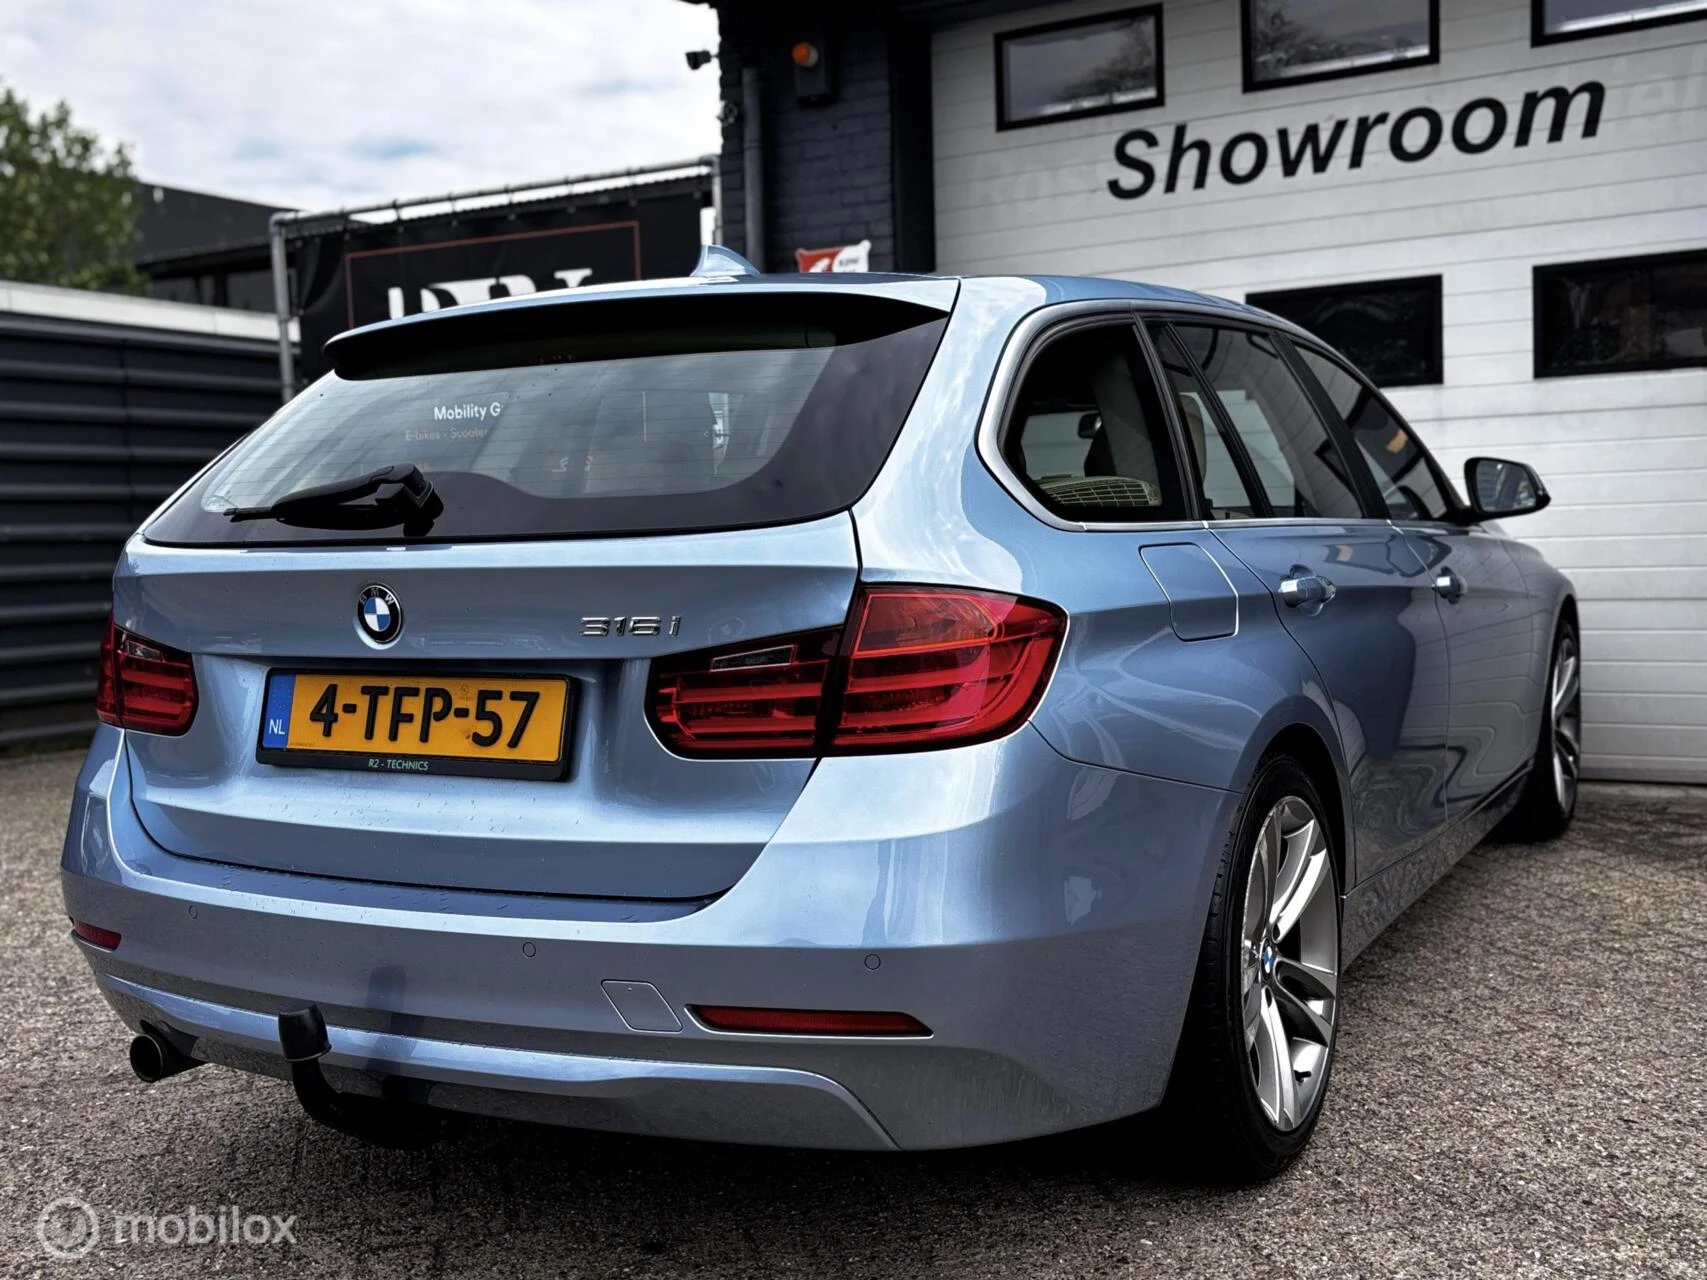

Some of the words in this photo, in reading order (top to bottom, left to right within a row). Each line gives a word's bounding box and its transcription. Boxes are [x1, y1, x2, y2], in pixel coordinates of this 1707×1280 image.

[1107, 80, 1607, 200] Showroom
[434, 403, 487, 421] Mobility
[360, 587, 395, 605] BMW
[309, 683, 541, 749] 4-TFP-57
[268, 718, 286, 736] NL
[368, 758, 379, 768] R2
[386, 759, 429, 771] TECHNICS
